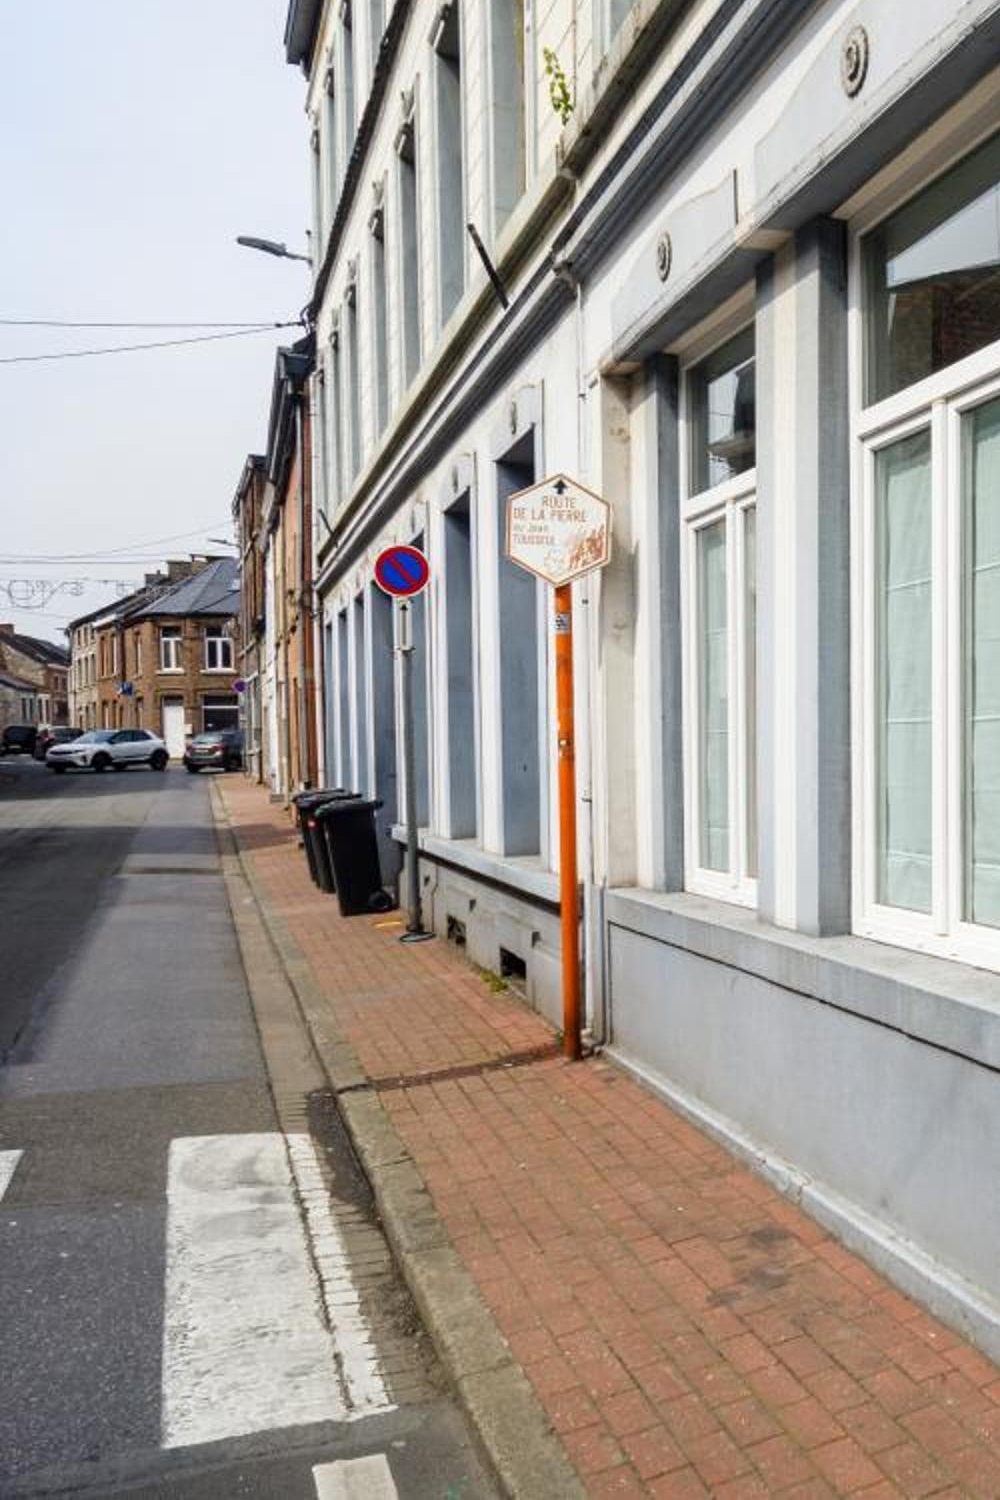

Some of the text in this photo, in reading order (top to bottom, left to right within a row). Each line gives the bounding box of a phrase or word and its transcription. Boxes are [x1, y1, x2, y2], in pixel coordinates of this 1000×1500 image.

[542, 495, 577, 509] ROUTE
[513, 507, 587, 523] DE LA PIERRE
